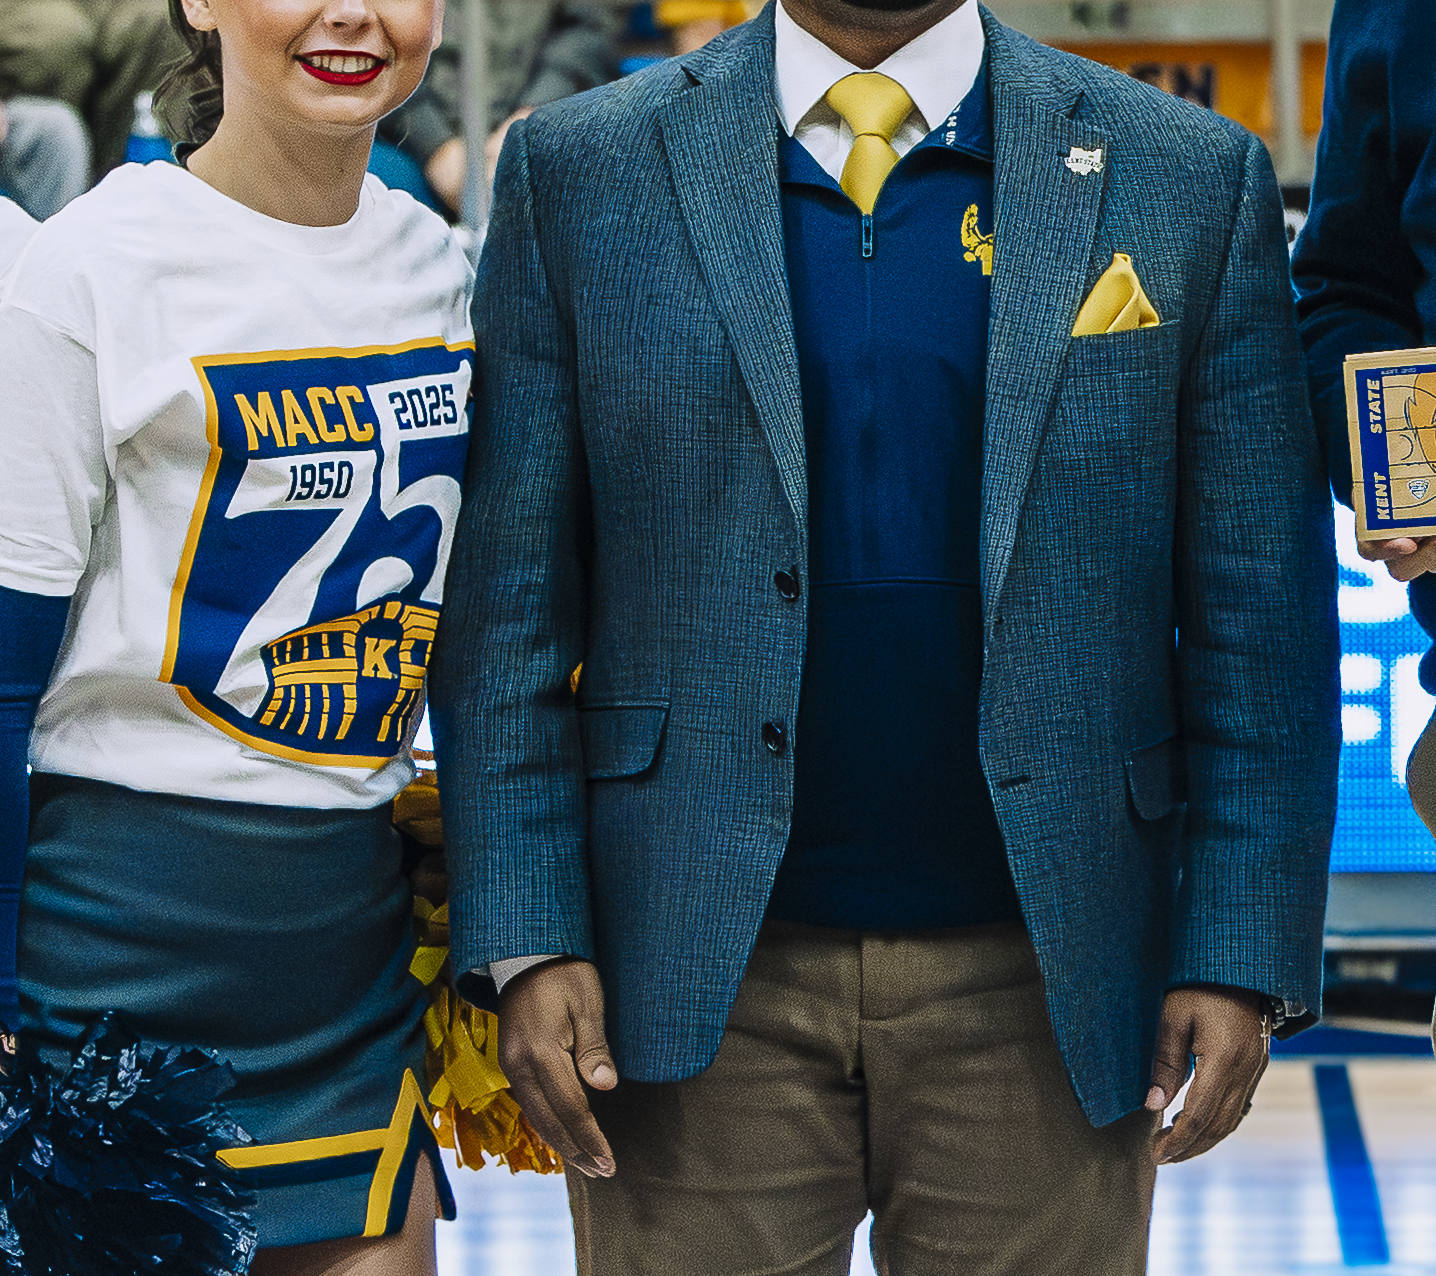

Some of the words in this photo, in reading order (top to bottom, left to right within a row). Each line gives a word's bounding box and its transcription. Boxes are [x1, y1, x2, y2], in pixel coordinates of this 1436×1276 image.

[236, 386, 374, 451] MACC
[387, 384, 458, 430] 2025
[1366, 378, 1382, 434] STATE
[285, 460, 353, 503] 1950
[1377, 471, 1391, 520] KENT
[362, 635, 399, 680] K
